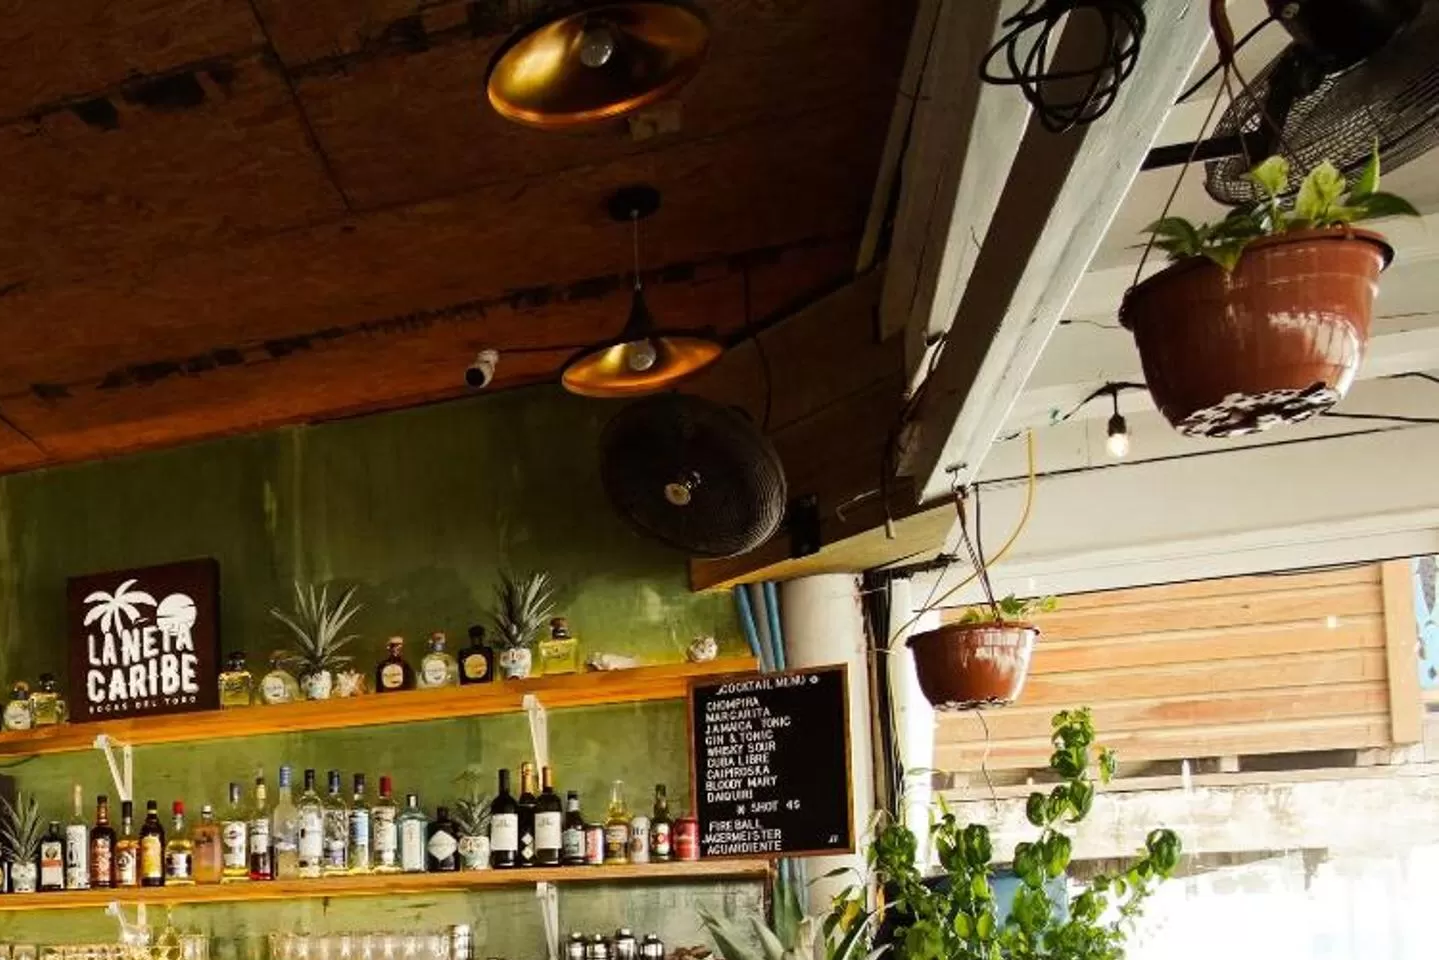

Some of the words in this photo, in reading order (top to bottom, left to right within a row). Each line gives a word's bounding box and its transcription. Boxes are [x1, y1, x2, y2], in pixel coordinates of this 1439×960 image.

[87, 653, 199, 703] CARIBE
[720, 679, 773, 694] COCKTAIL
[89, 702, 128, 714] BOCAS
[135, 699, 158, 711] DEL
[164, 696, 197, 706] TORO
[706, 707, 771, 723] MARGARITA
[705, 721, 752, 735] JAMAICA
[761, 716, 791, 729] TONIC
[705, 734, 724, 746] GIN
[729, 733, 737, 744] &
[740, 729, 774, 743] TONIC
[747, 741, 776, 754] SOUR
[707, 756, 735, 769] CUBA
[738, 752, 770, 767] LIBRE
[705, 778, 742, 792] BLOODY
[747, 775, 777, 788] MARY
[707, 789, 753, 803] DAIQUIRI
[751, 800, 779, 813] SHOT
